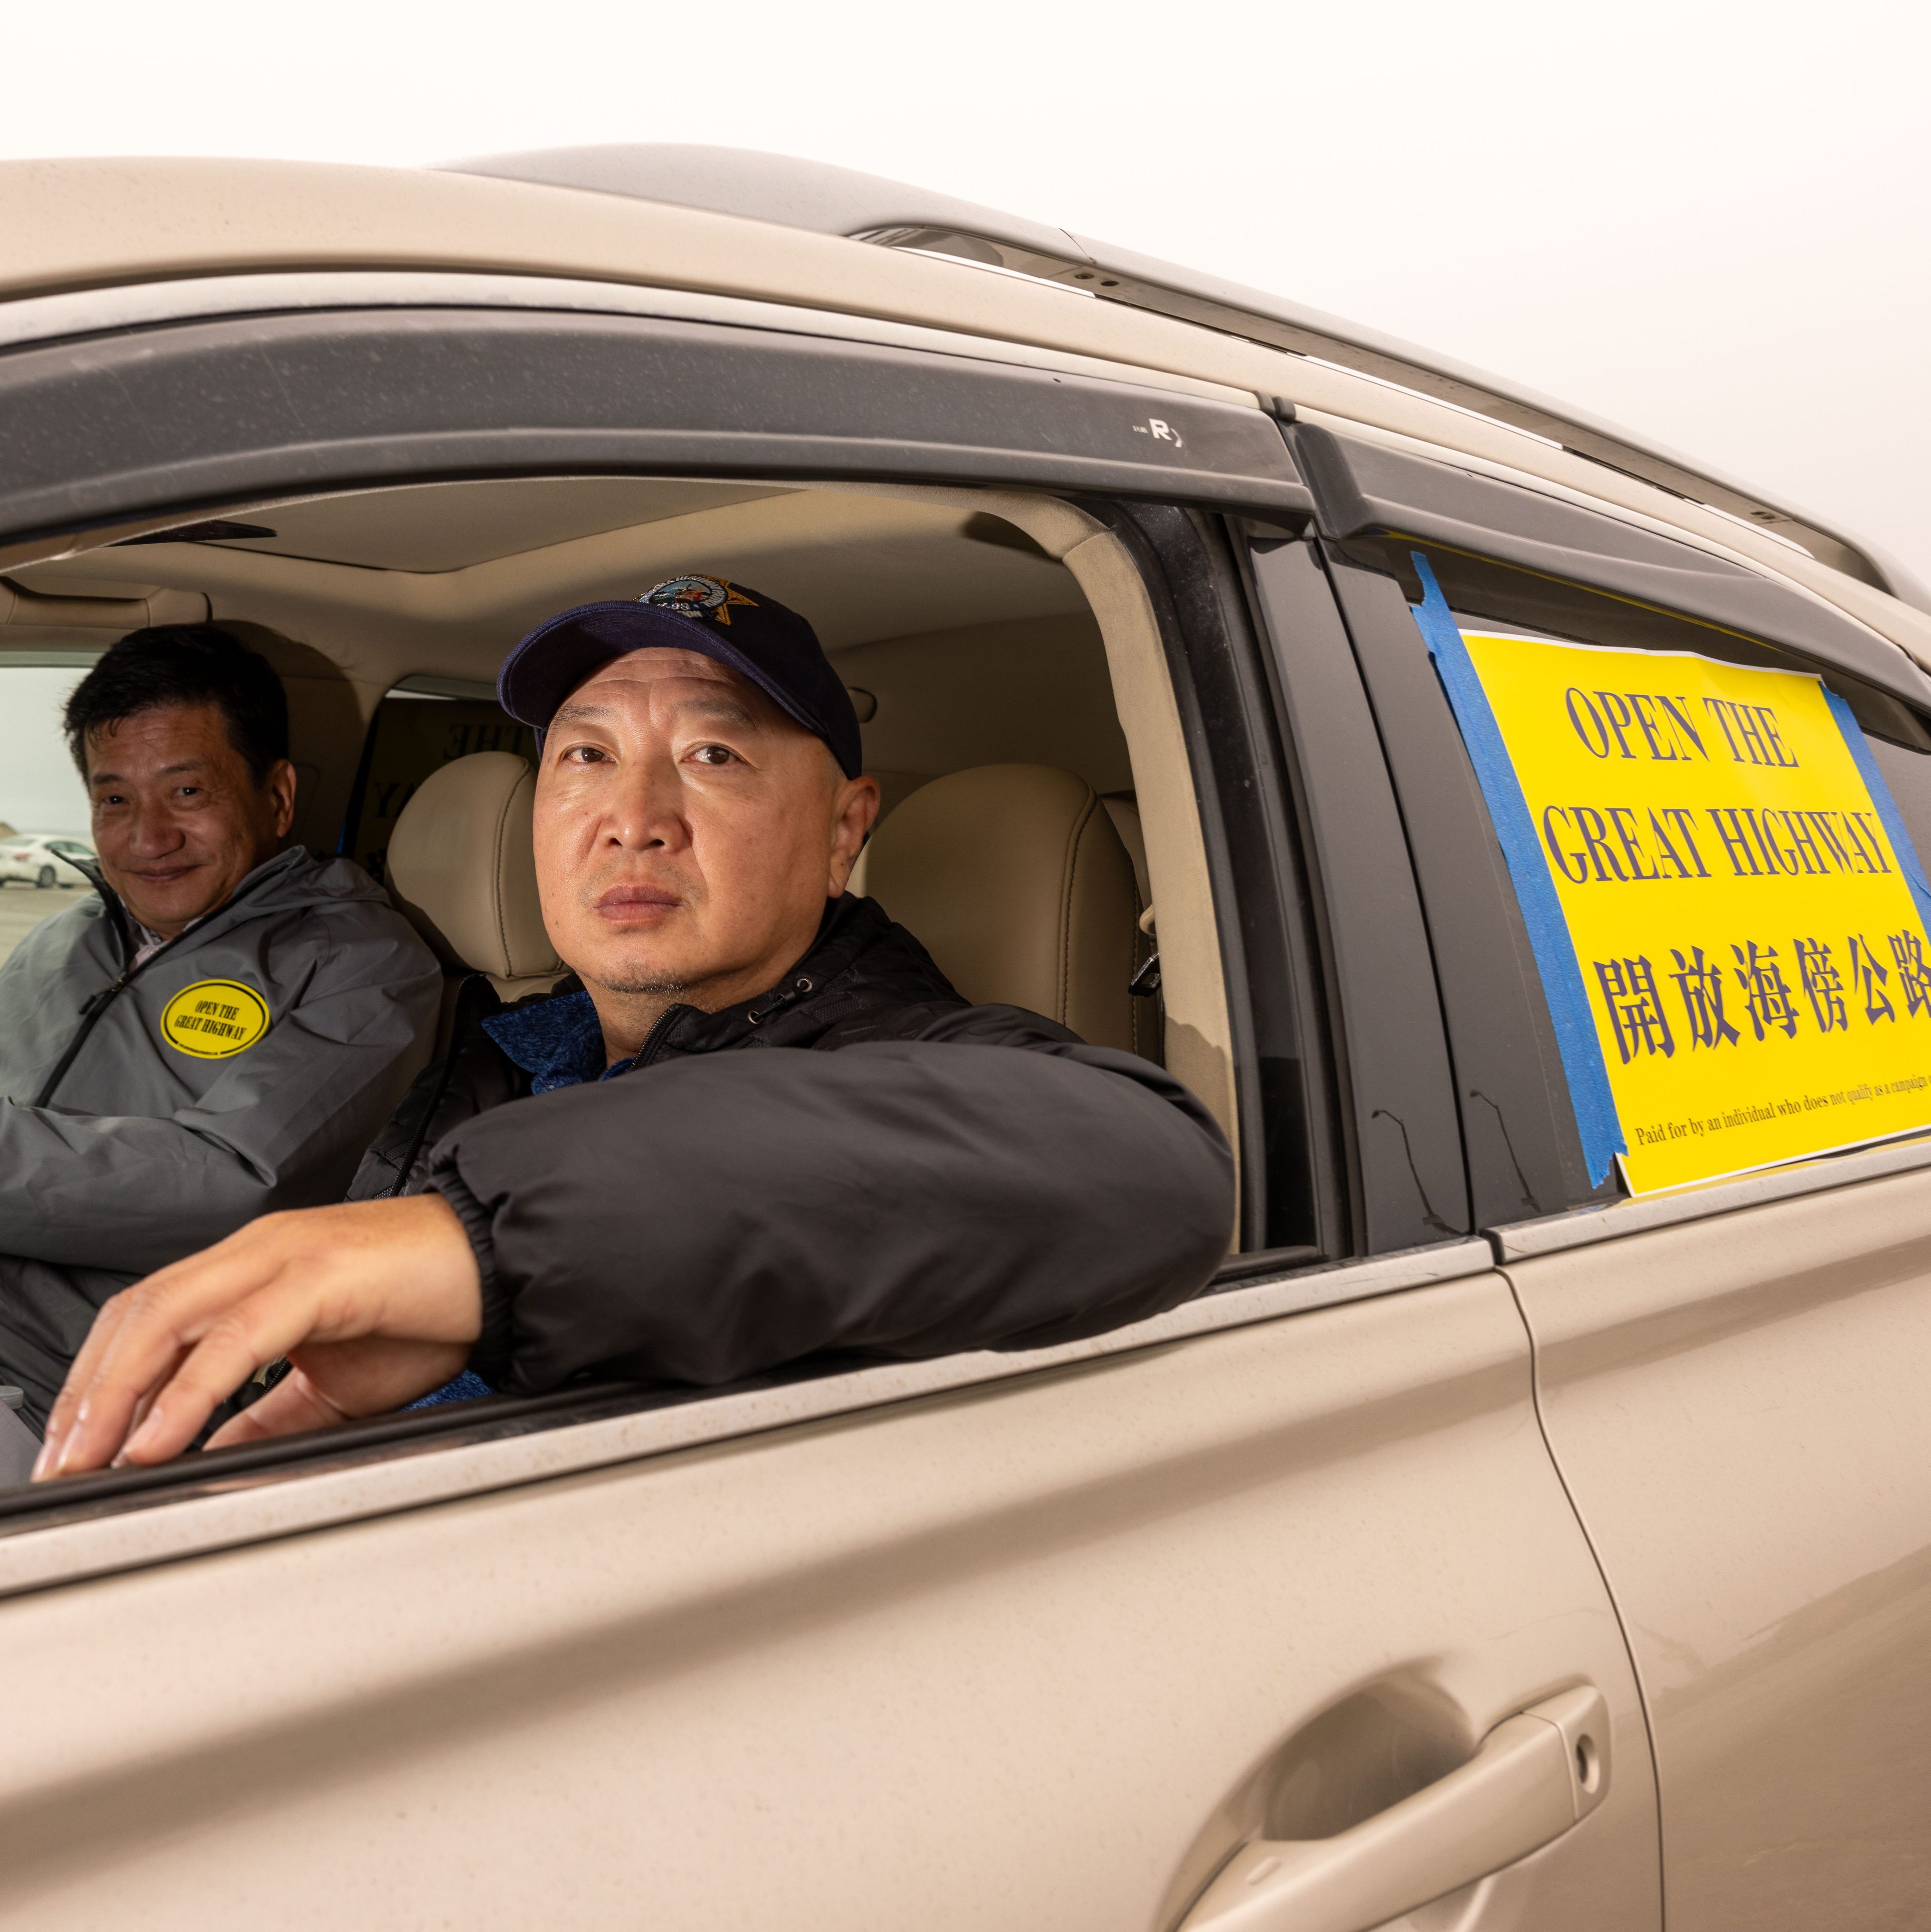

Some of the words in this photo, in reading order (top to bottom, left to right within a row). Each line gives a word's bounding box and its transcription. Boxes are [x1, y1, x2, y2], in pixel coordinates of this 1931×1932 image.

[1565, 687, 1709, 762] OPEN
[1702, 697, 1799, 768] THE
[1543, 805, 1712, 884] GREAT
[1705, 808, 1892, 876] HIGHWAY
[174, 1015, 203, 1031] GREAT
[201, 1019, 247, 1040] HIGHWAY
[195, 1000, 220, 1016] OPEN
[218, 1004, 239, 1021] THE
[1593, 929, 1931, 1065] 開放海傍公路
[1634, 1124, 1667, 1146] Paid
[1667, 1122, 1687, 1139] for
[1688, 1118, 1704, 1137] by
[1707, 1118, 1722, 1131] an
[1721, 1102, 1777, 1128] individual
[1776, 1099, 1801, 1116] who
[1803, 1095, 1829, 1111] does
[1829, 1090, 1847, 1106] not
[1846, 1083, 1874, 1105] qualify
[1874, 1085, 1884, 1097] as
[1884, 1083, 1891, 1095] a
[1890, 1074, 1928, 1094] campaign
